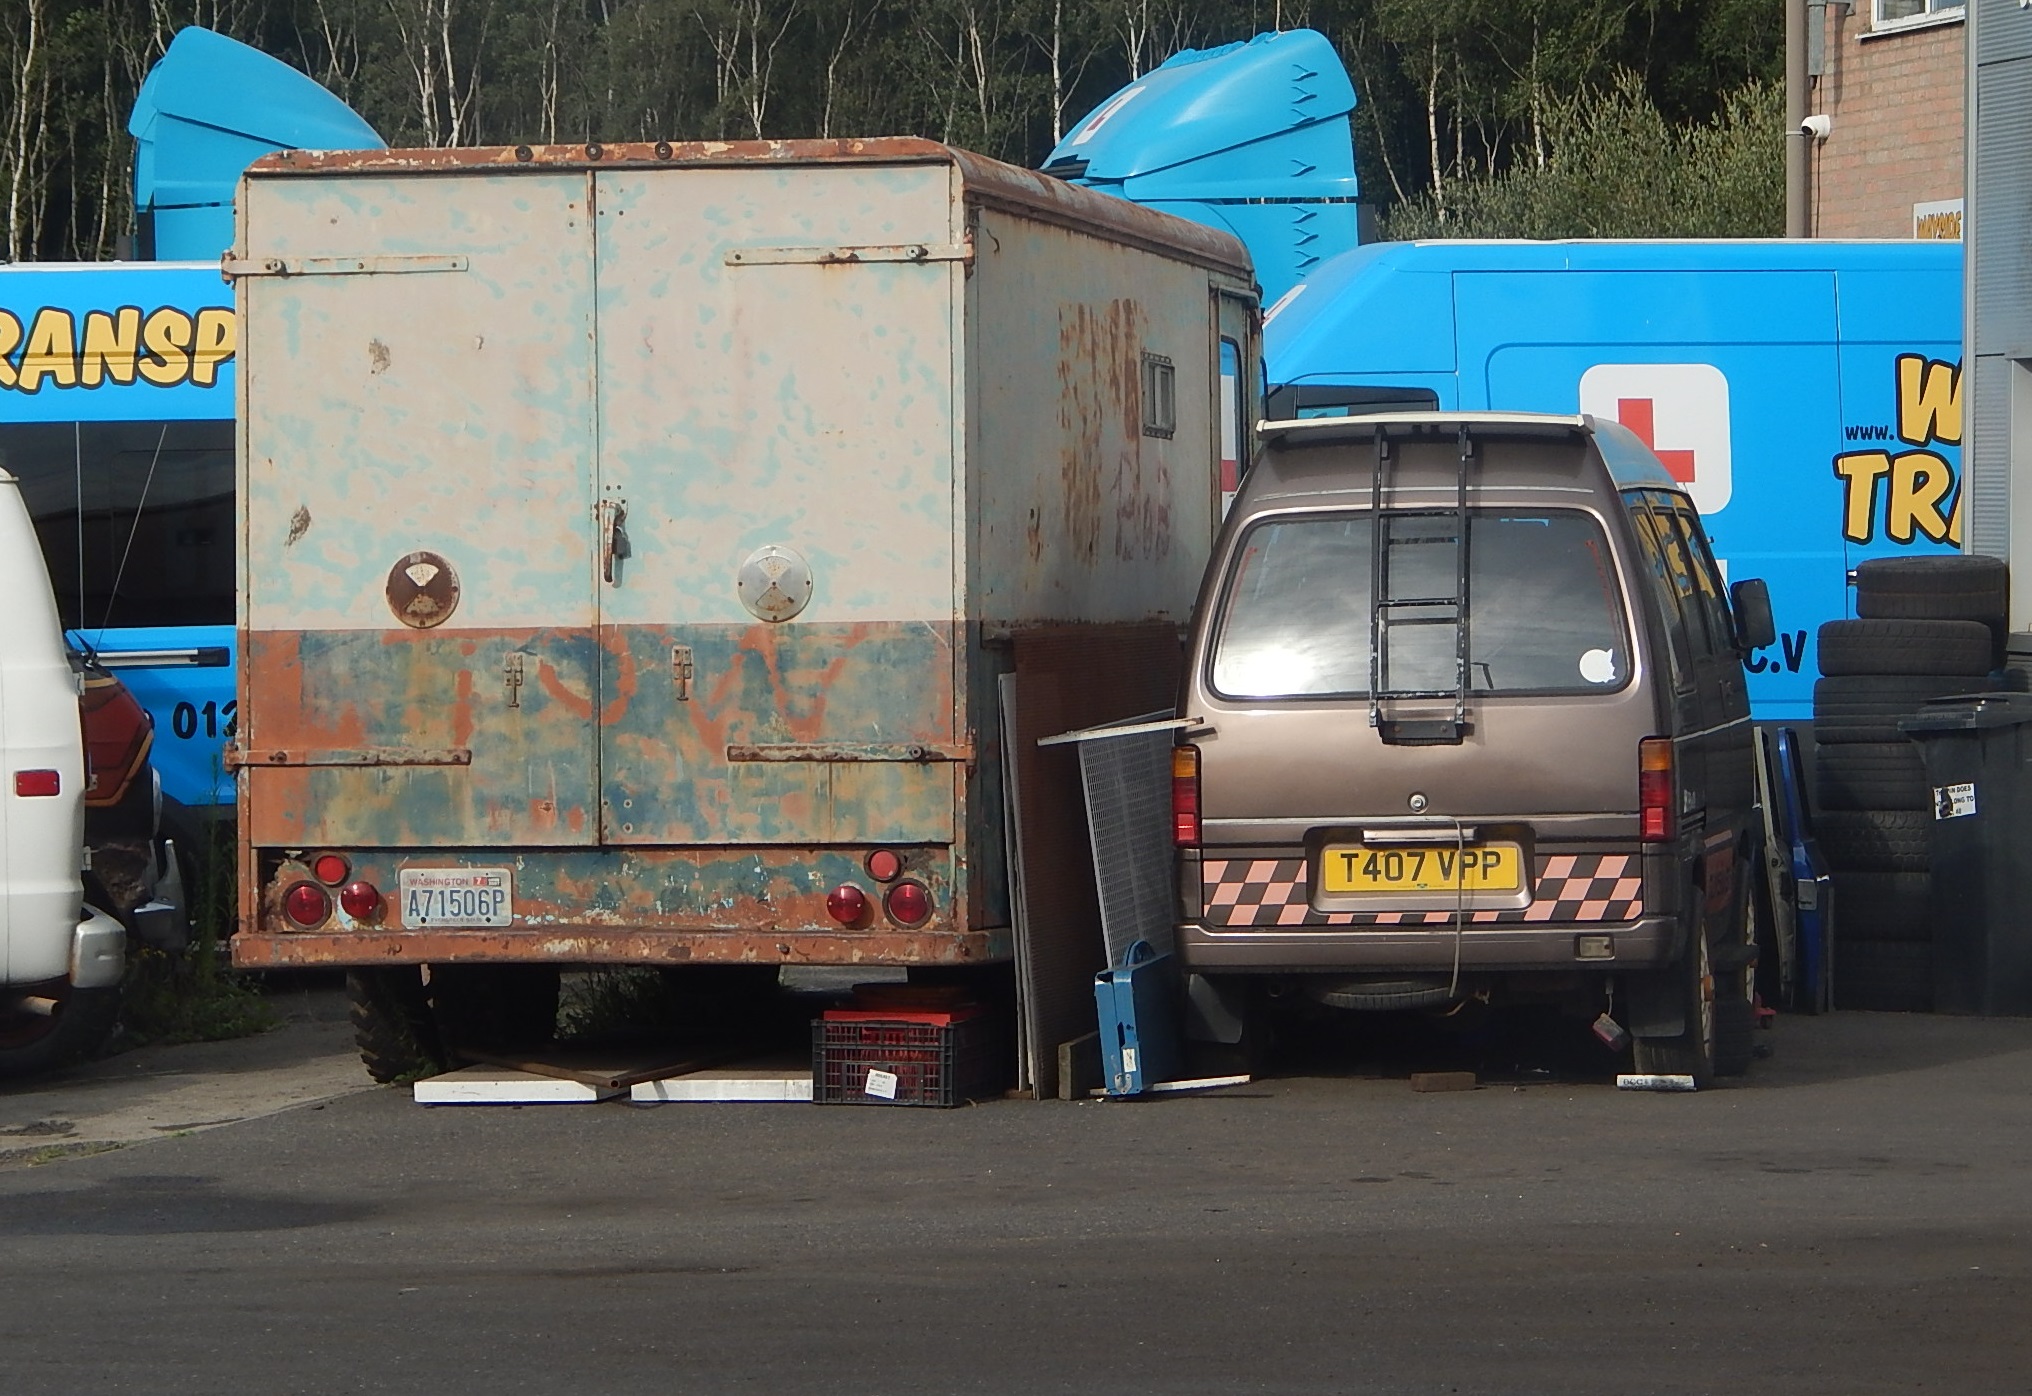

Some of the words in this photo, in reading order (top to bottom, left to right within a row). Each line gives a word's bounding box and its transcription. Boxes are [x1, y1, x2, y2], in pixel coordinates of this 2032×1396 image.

[1832, 449, 1962, 549] TR
[1340, 850, 1426, 883] T407
[1436, 849, 1502, 882] VPP
[409, 878, 469, 886] WASHINGTON
[408, 889, 505, 917] A71506P
